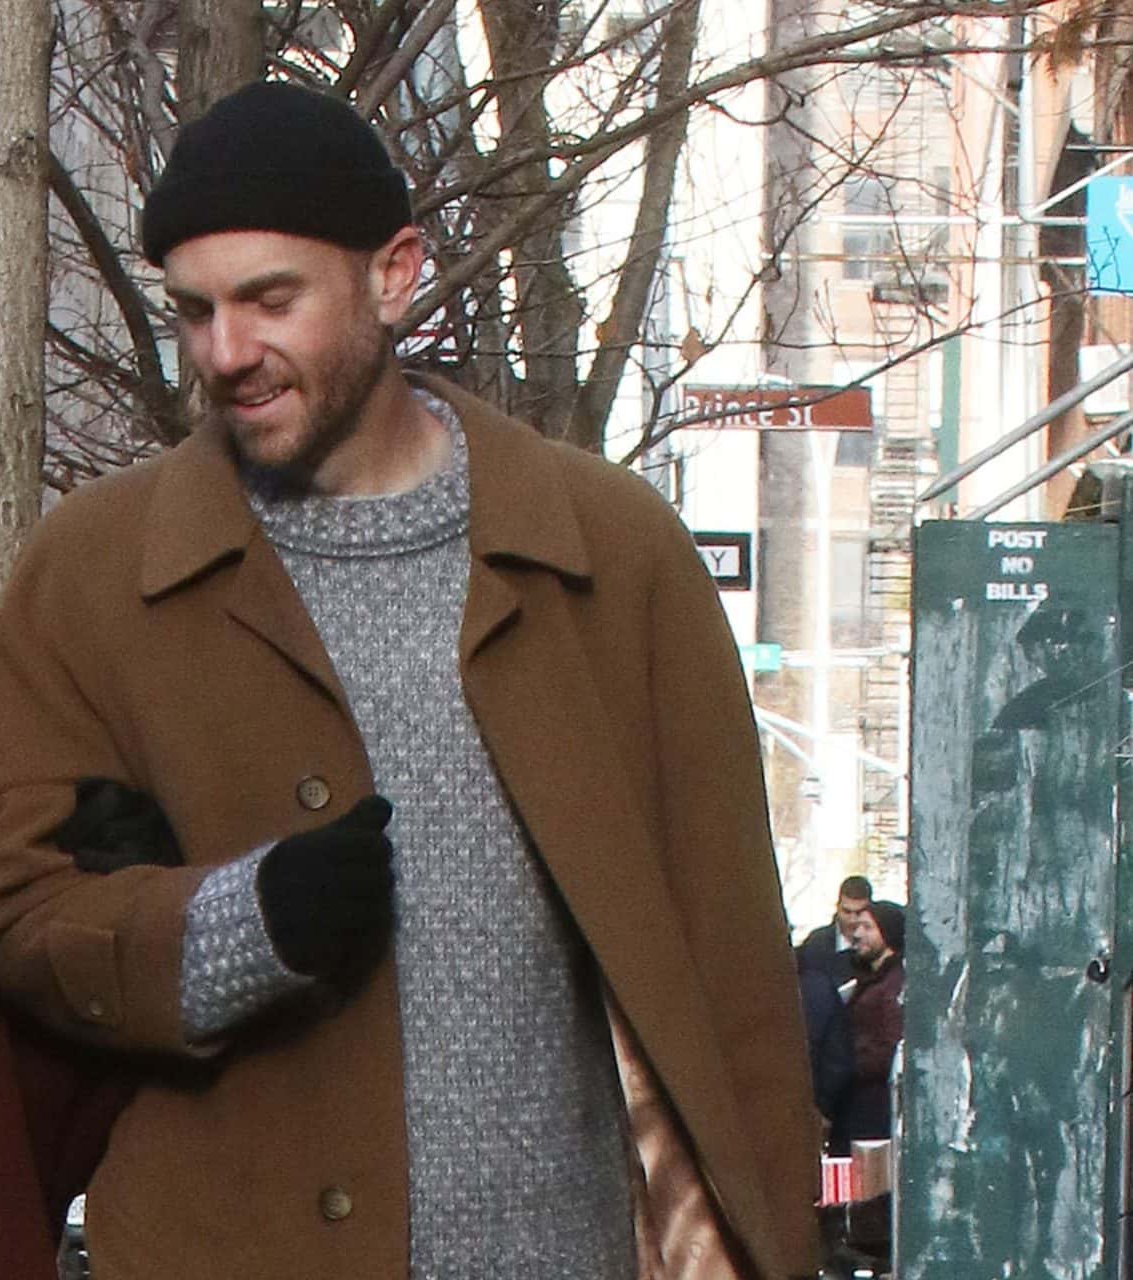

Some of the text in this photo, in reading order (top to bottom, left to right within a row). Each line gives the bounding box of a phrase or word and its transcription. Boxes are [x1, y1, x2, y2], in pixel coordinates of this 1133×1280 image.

[685, 393, 813, 426] Prince St
[988, 530, 1048, 549] POST
[1001, 556, 1034, 574] NO
[986, 583, 1049, 600] BILLS
